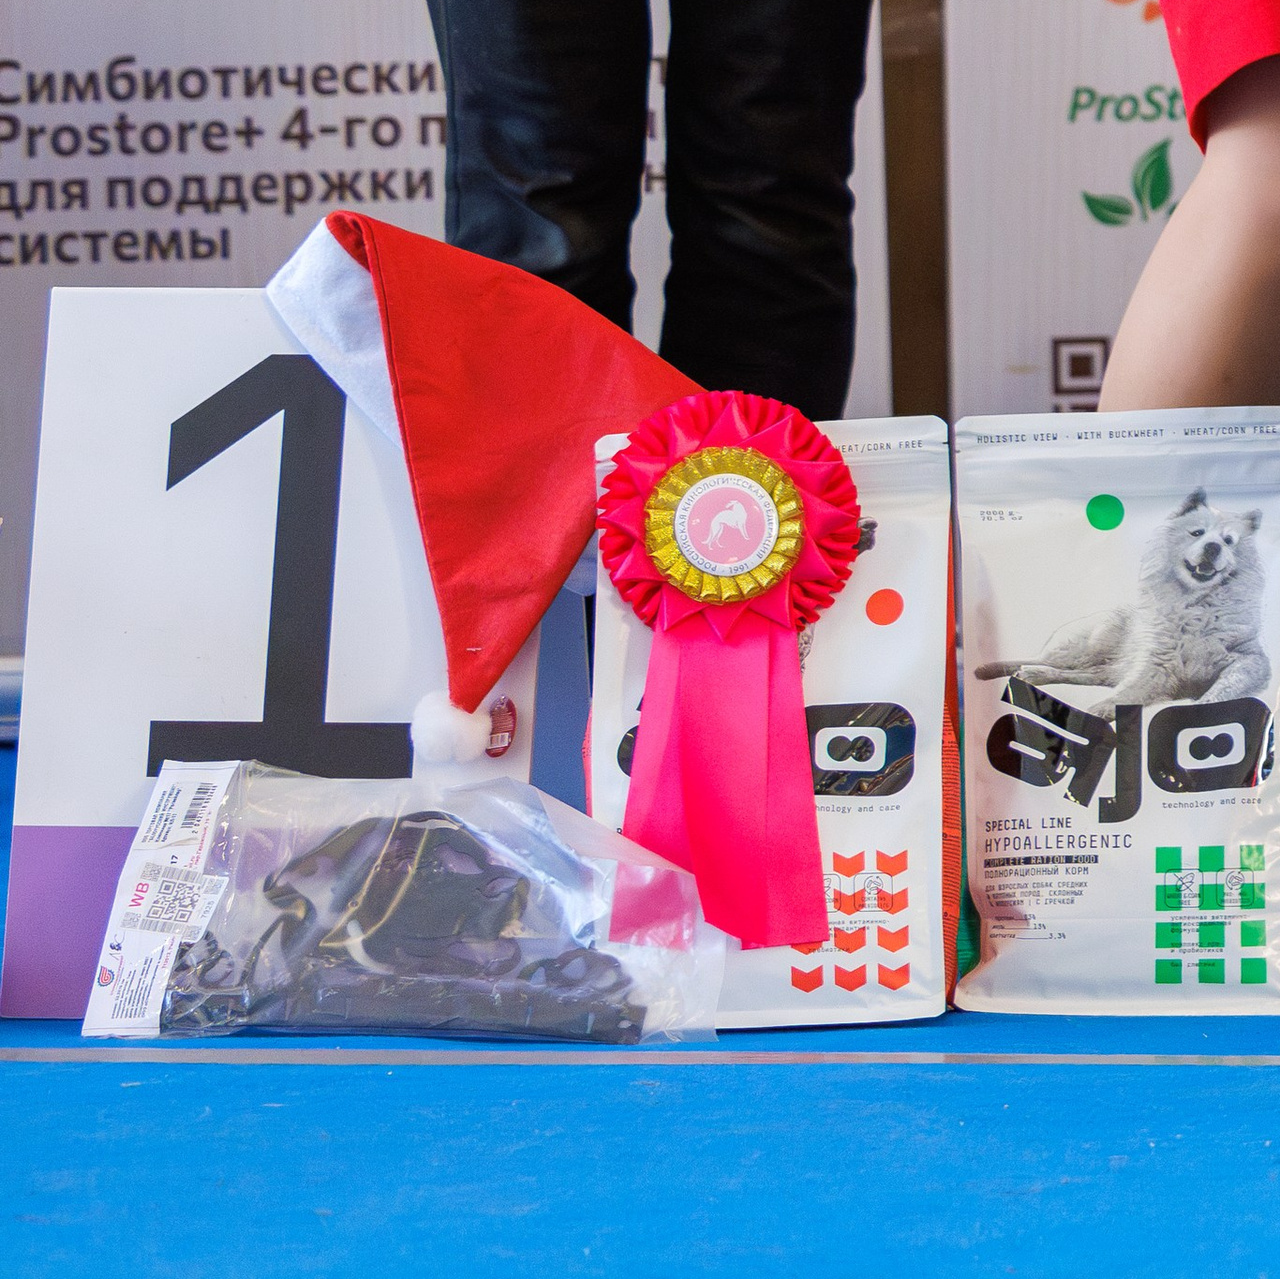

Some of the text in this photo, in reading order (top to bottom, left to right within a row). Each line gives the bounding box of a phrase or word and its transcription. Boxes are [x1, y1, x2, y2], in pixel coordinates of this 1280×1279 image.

[0, 55, 444, 105] Симбиотически
[1067, 83, 1186, 124] ProSt
[280, 106, 403, 150] 4-го
[106, 168, 434, 218] поддержки
[898, 439, 923, 449] FREE
[977, 425, 1278, 444] HOLISTIC VIEW WITH BUCKWHEAT WHEAT/CORN FREE
[147, 354, 414, 779] 1
[857, 805, 874, 813] and
[879, 803, 901, 812] care
[1162, 796, 1262, 810] technology and care
[985, 817, 1072, 833] SPECIAL LINE
[985, 834, 1133, 853] HYPOALLERGENIC
[1065, 867, 1089, 876] КОРМ
[128, 882, 149, 908] WB
